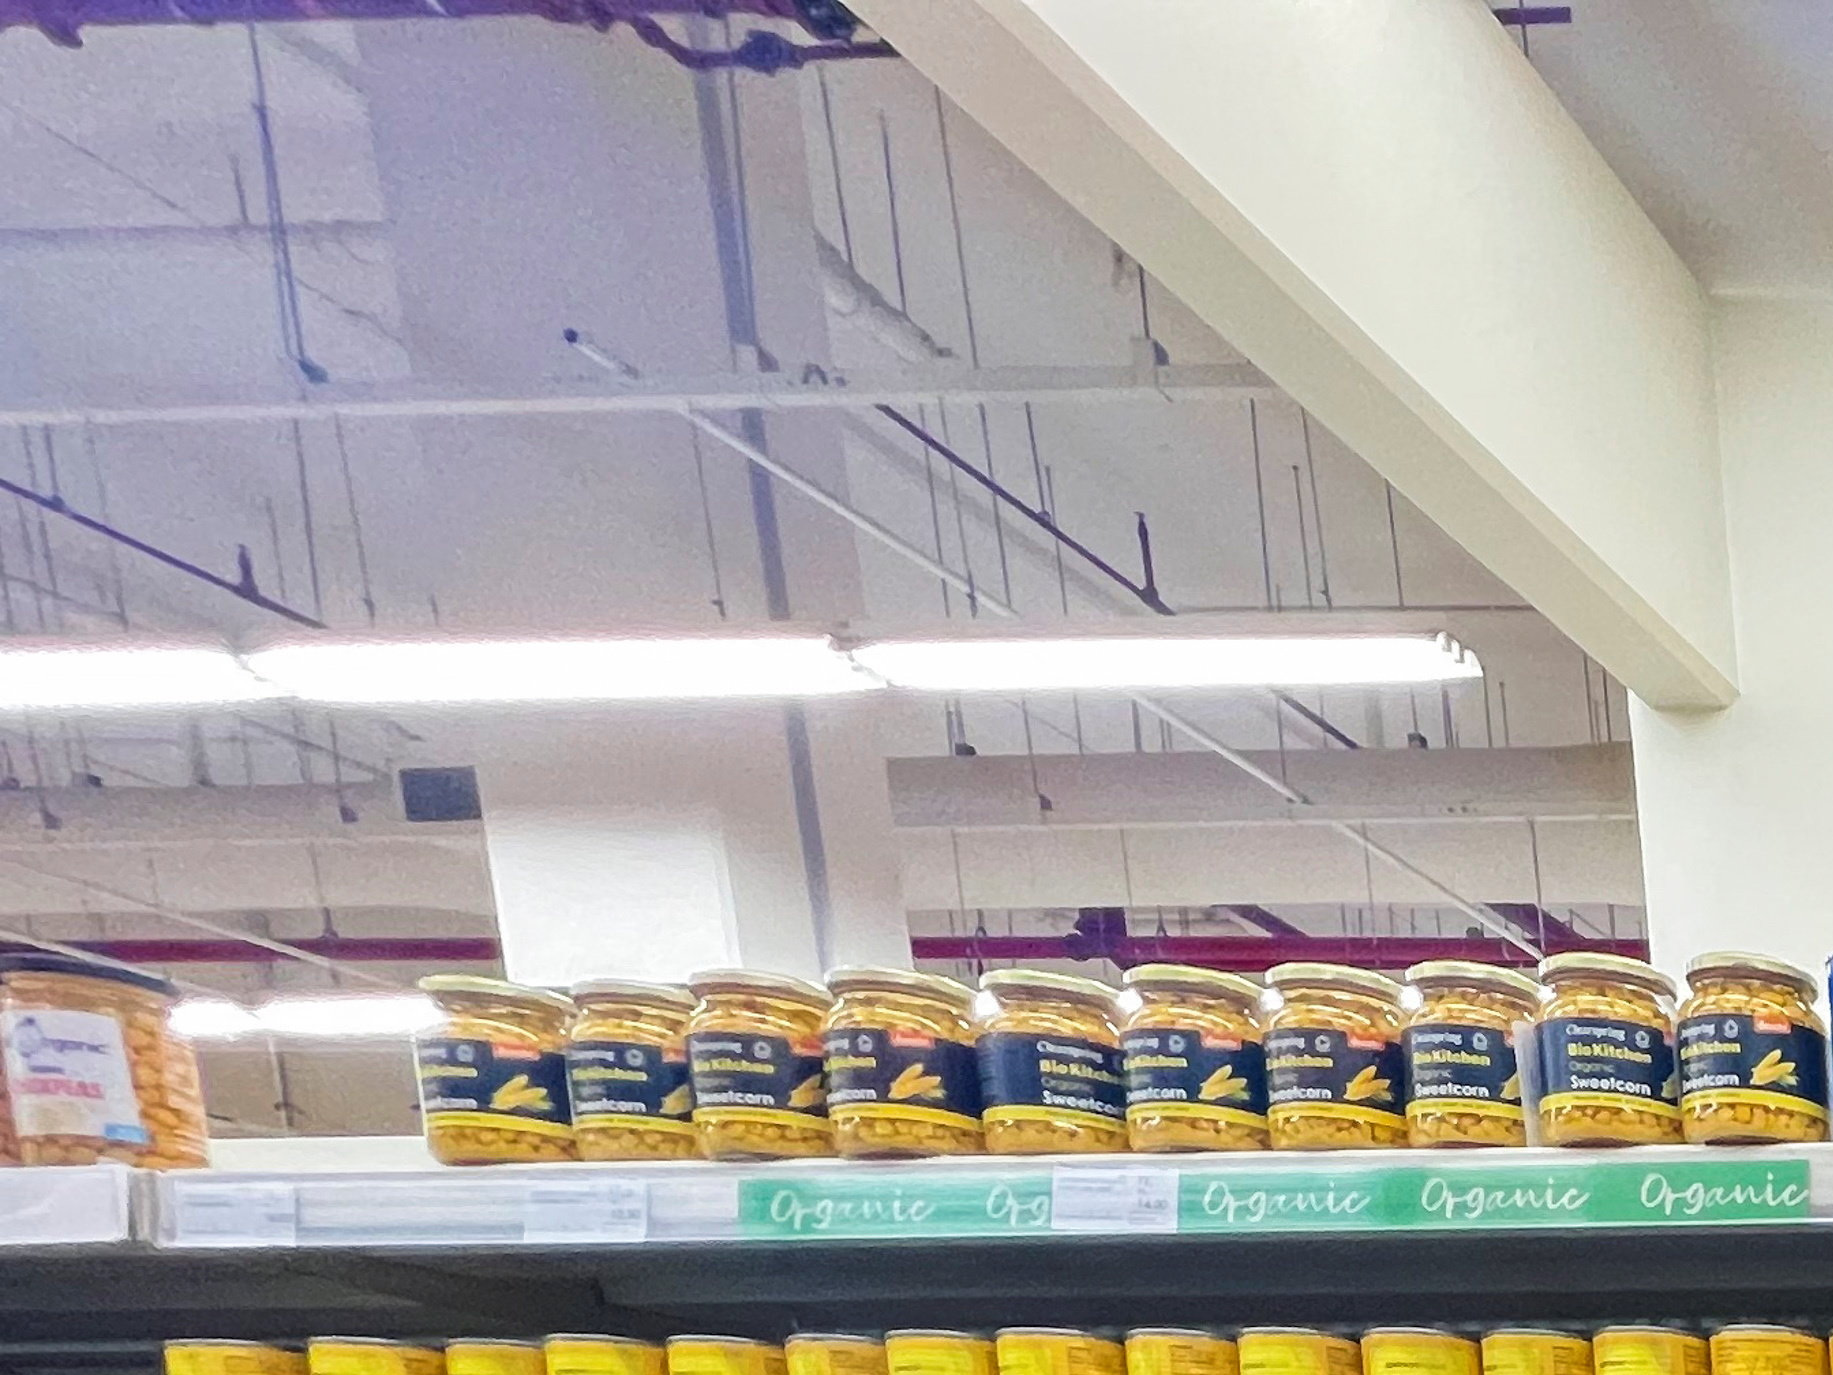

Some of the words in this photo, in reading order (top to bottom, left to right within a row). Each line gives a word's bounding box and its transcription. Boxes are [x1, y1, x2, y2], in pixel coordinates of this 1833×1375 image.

[1570, 1073, 1652, 1096] Sweetcorn
[769, 1190, 937, 1230] Organic
[1203, 1178, 1372, 1224] Organic
[1421, 1175, 1592, 1220] Organic
[1639, 1171, 1810, 1217] Organic
